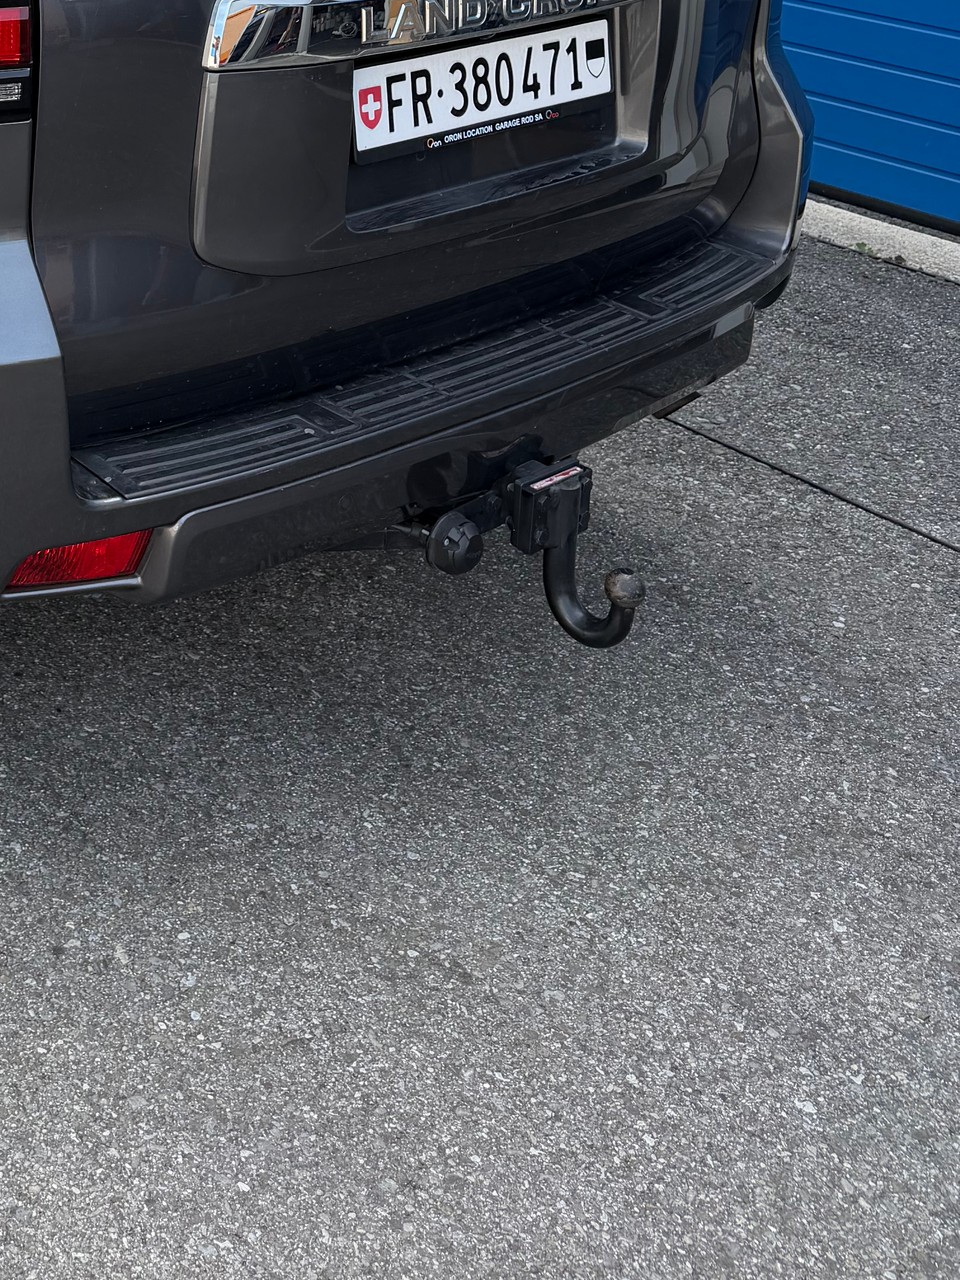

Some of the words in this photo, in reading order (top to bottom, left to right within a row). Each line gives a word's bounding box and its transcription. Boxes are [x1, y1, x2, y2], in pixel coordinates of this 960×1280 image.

[444, 131, 463, 144] ORON
[462, 124, 494, 139] LOCATION
[495, 118, 521, 131] GARAGE
[521, 115, 534, 125] ROD
[534, 112, 544, 122] SA
